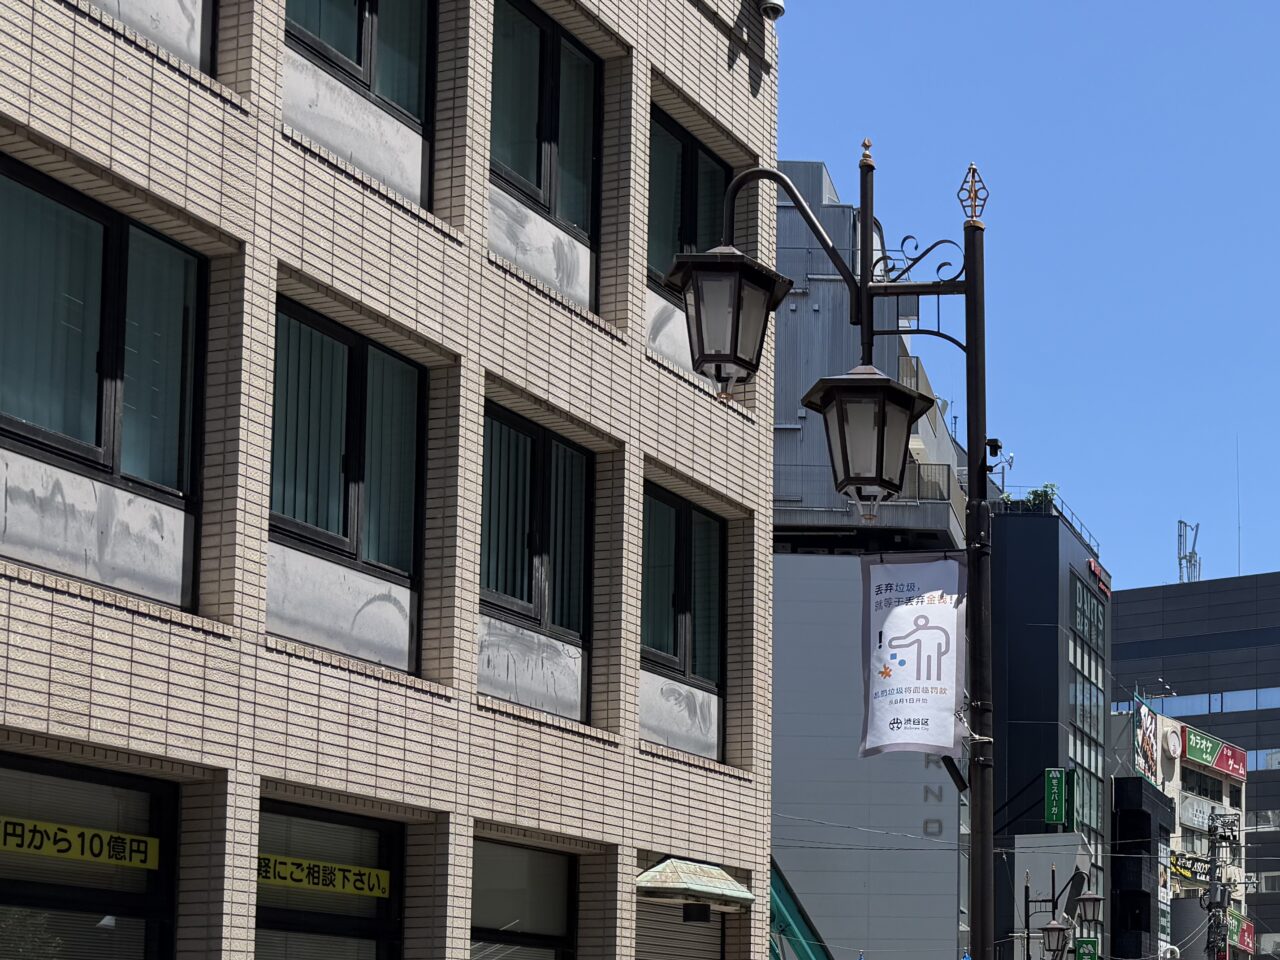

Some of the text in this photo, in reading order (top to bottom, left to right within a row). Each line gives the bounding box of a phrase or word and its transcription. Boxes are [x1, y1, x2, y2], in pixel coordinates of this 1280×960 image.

[903, 717, 930, 726] 渋谷区
[1189, 733, 1213, 752] カラオケ
[1228, 759, 1245, 776] ゲーム
[1051, 780, 1059, 821] モスバーガー
[0, 820, 148, 864] 円から10億円
